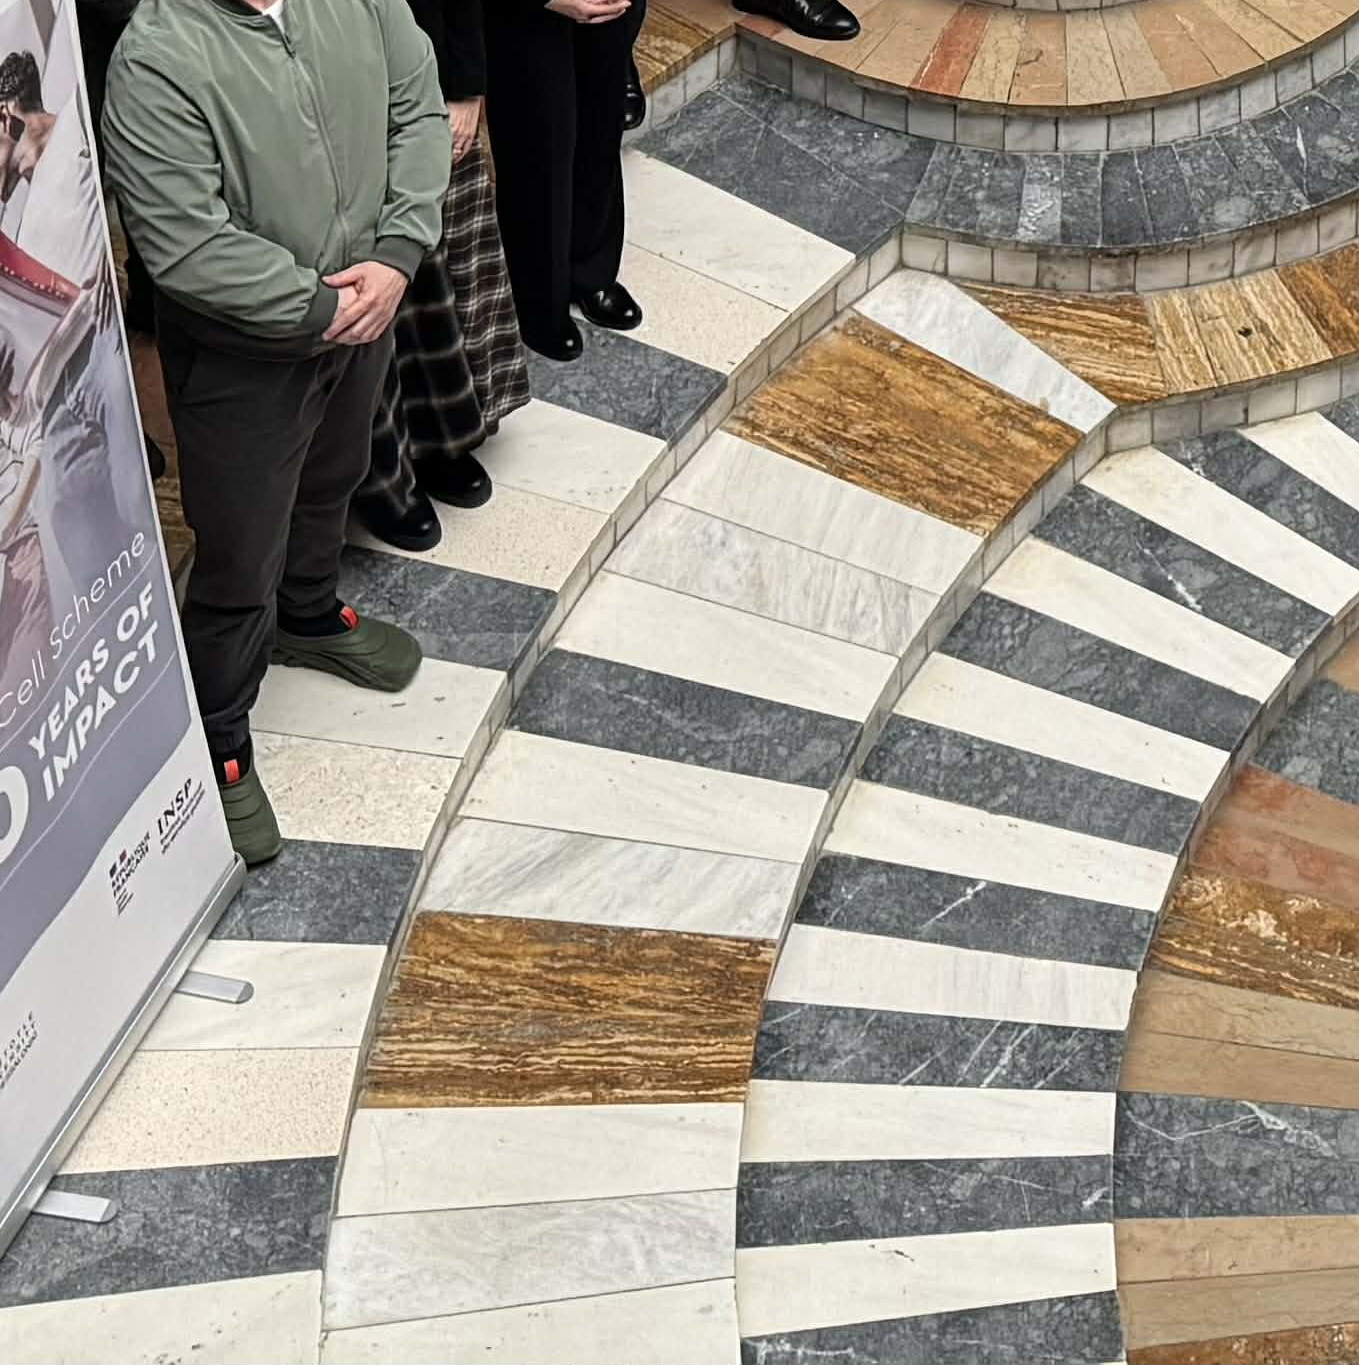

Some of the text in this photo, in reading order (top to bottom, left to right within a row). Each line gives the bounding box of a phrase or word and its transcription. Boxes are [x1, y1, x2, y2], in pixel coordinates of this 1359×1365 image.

[29, 581, 155, 758] YEARS OF
[41, 621, 160, 802] IMPACT
[157, 778, 192, 836] INSP
